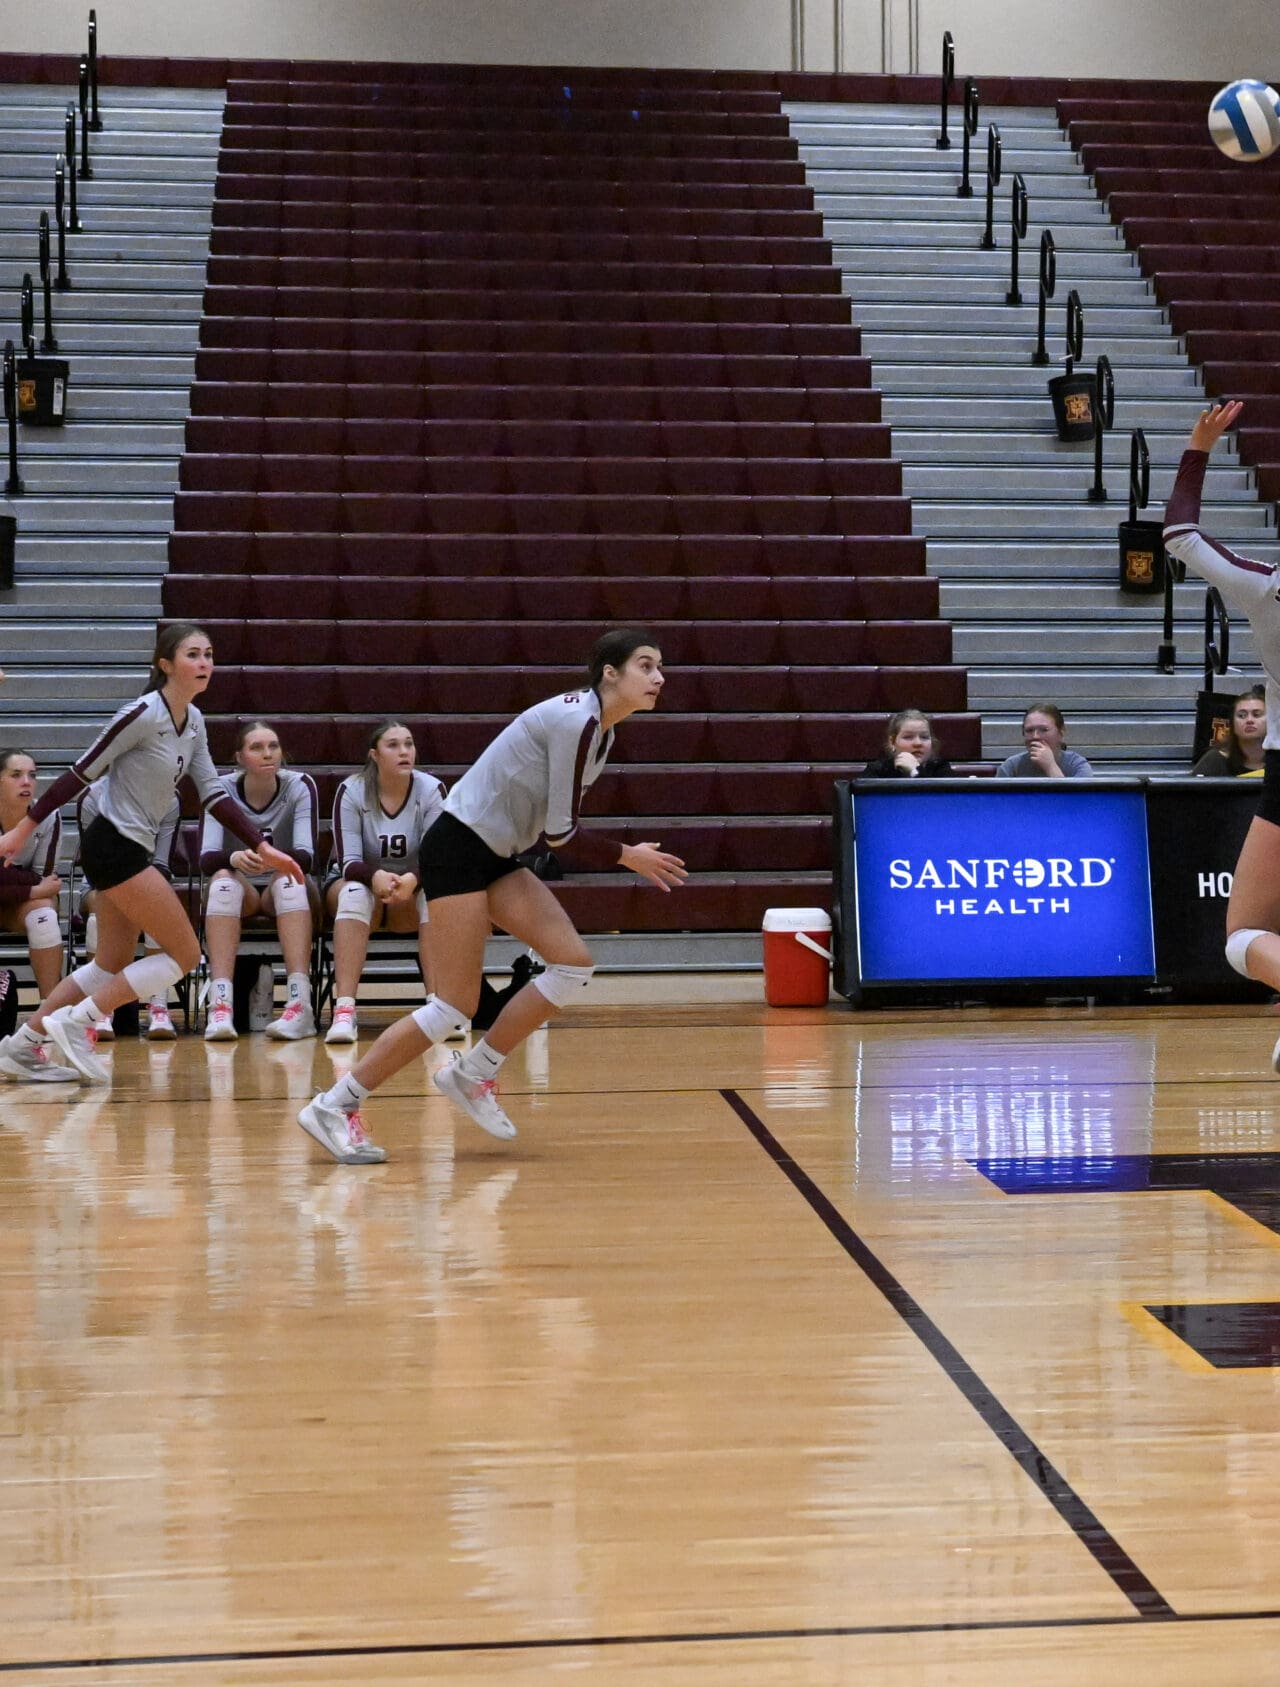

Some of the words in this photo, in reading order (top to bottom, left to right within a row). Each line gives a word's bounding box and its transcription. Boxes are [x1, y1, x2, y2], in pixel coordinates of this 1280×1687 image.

[378, 834, 407, 859] 19
[889, 858, 1114, 889] SANFORD
[1198, 871, 1234, 898] HO
[935, 898, 1070, 915] HEALTH
